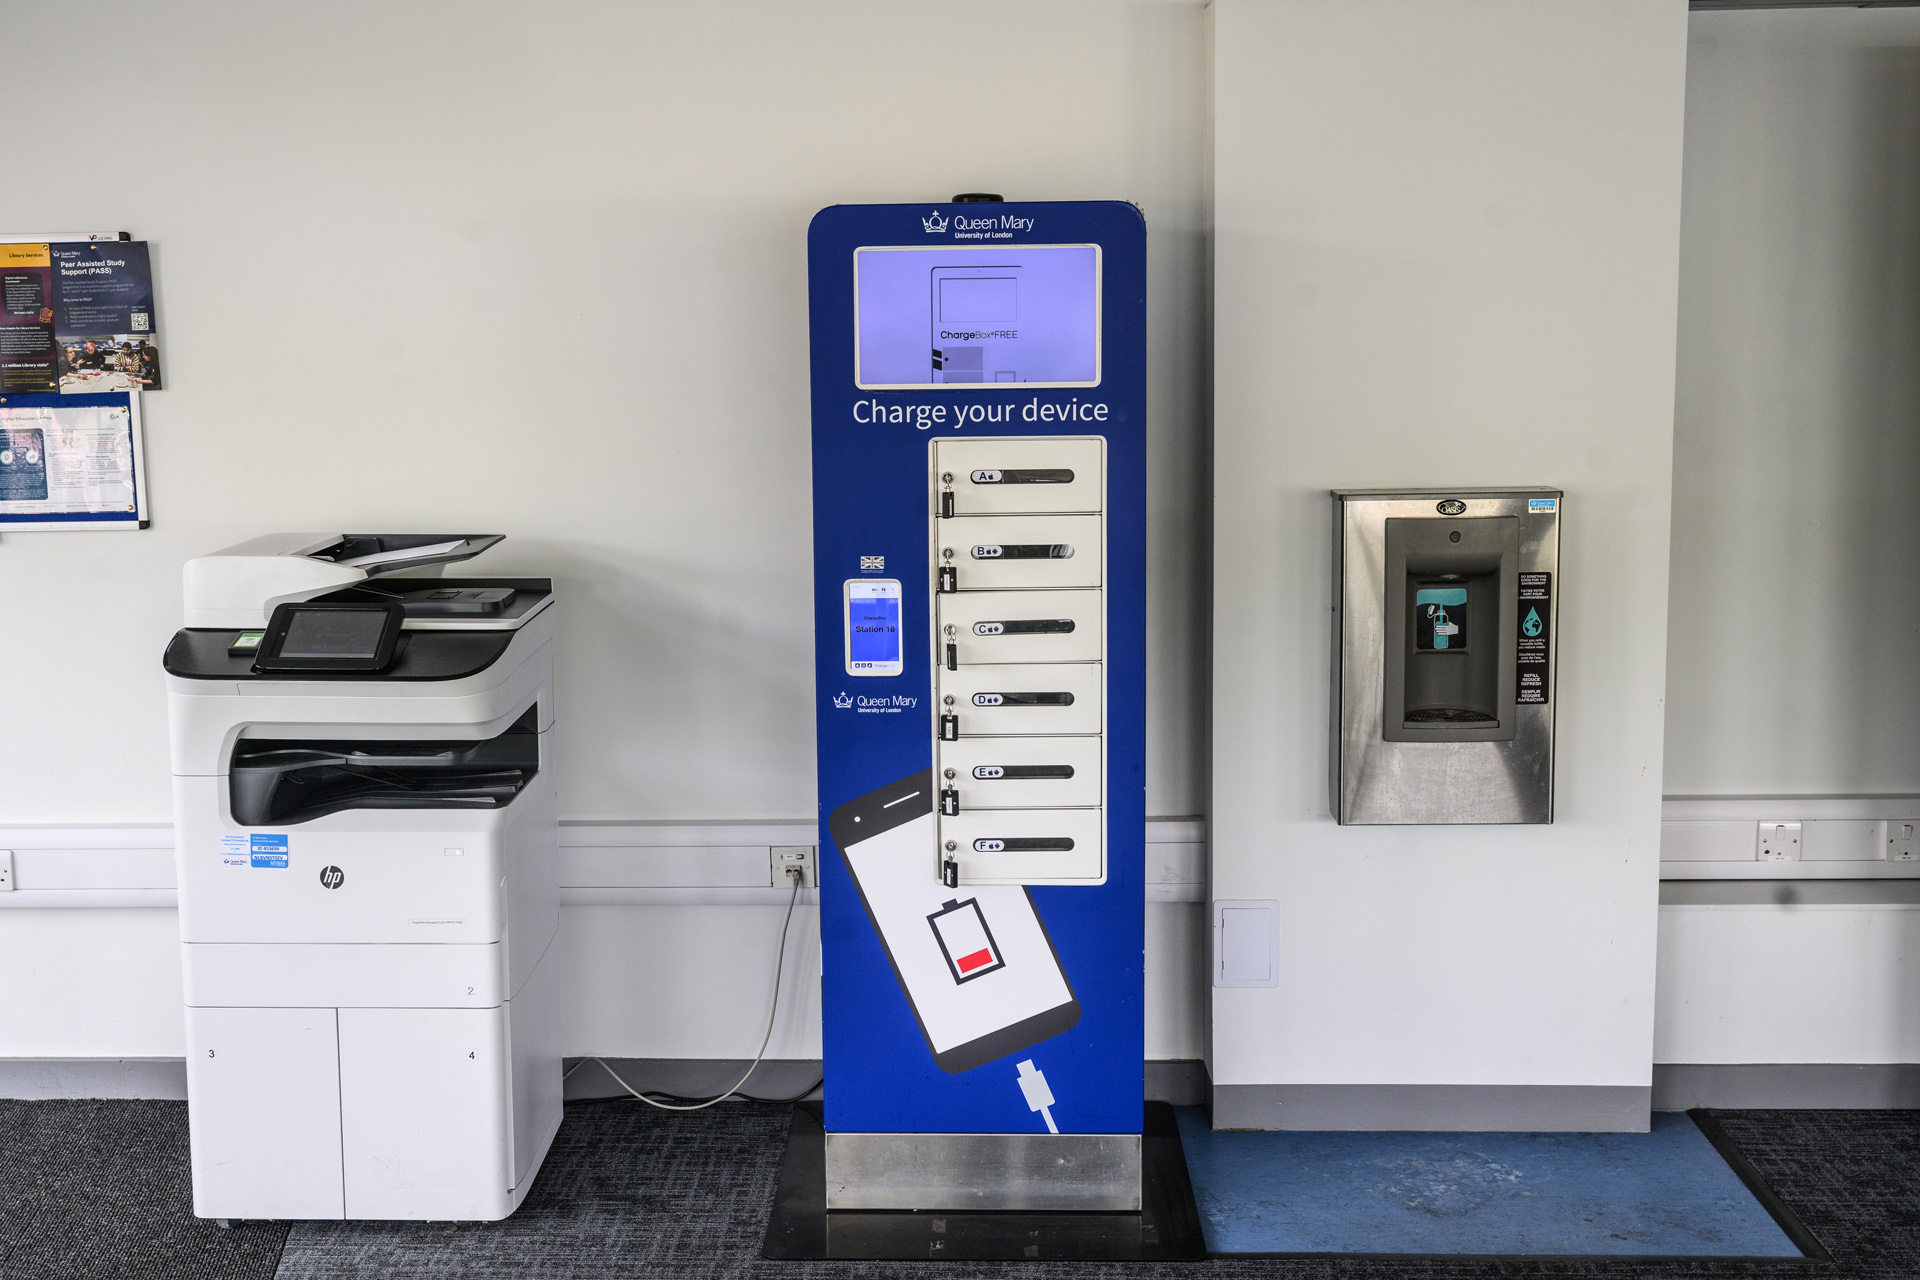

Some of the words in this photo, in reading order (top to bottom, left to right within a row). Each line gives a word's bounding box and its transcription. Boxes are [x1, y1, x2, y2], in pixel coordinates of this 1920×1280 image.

[954, 215, 998, 232] Queen
[1000, 215, 1034, 232] Mary
[954, 232, 983, 240] University
[106, 259, 125, 267] Study
[88, 267, 112, 275] (PASS)
[853, 399, 947, 430] Charge
[953, 402, 1015, 429] your
[1022, 398, 1109, 422] device
[979, 472, 987, 481] A
[977, 547, 985, 555] B
[978, 625, 986, 634] C
[856, 695, 891, 706] Queen
[892, 695, 918, 709] Mary
[978, 695, 985, 704] D
[979, 768, 986, 776] E
[980, 842, 986, 850] F
[323, 865, 342, 890] hp
[467, 986, 474, 996] 2
[208, 1050, 215, 1058] 3
[468, 1051, 476, 1060] 4
